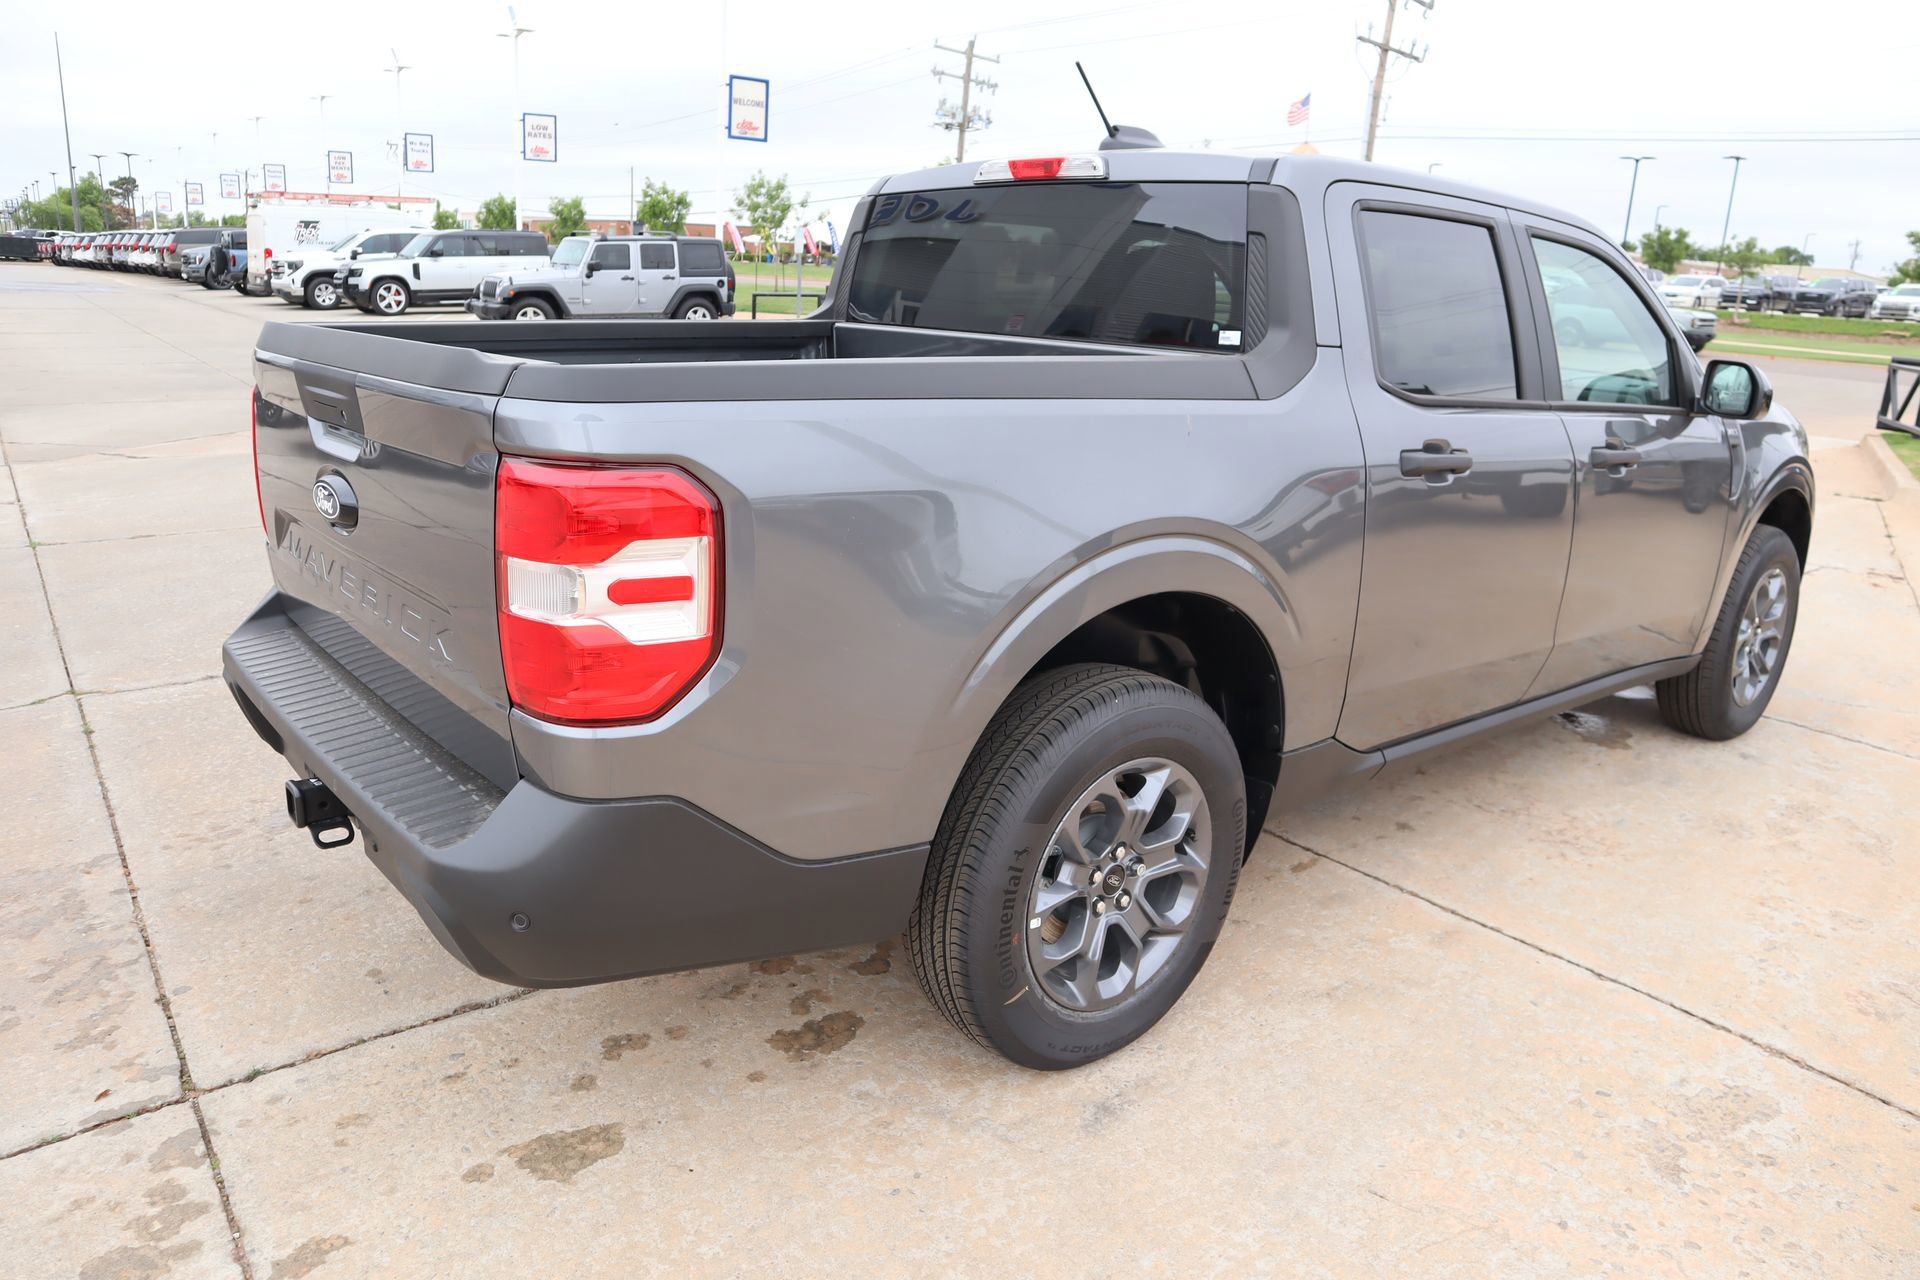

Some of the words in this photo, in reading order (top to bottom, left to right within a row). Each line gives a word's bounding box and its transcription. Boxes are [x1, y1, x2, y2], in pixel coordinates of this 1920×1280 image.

[527, 131, 553, 139] RATES
[733, 97, 764, 108] WELCOME
[287, 529, 453, 662] MAVERICK
[1222, 797, 1246, 906] Continental
[996, 864, 1025, 989] Continental
